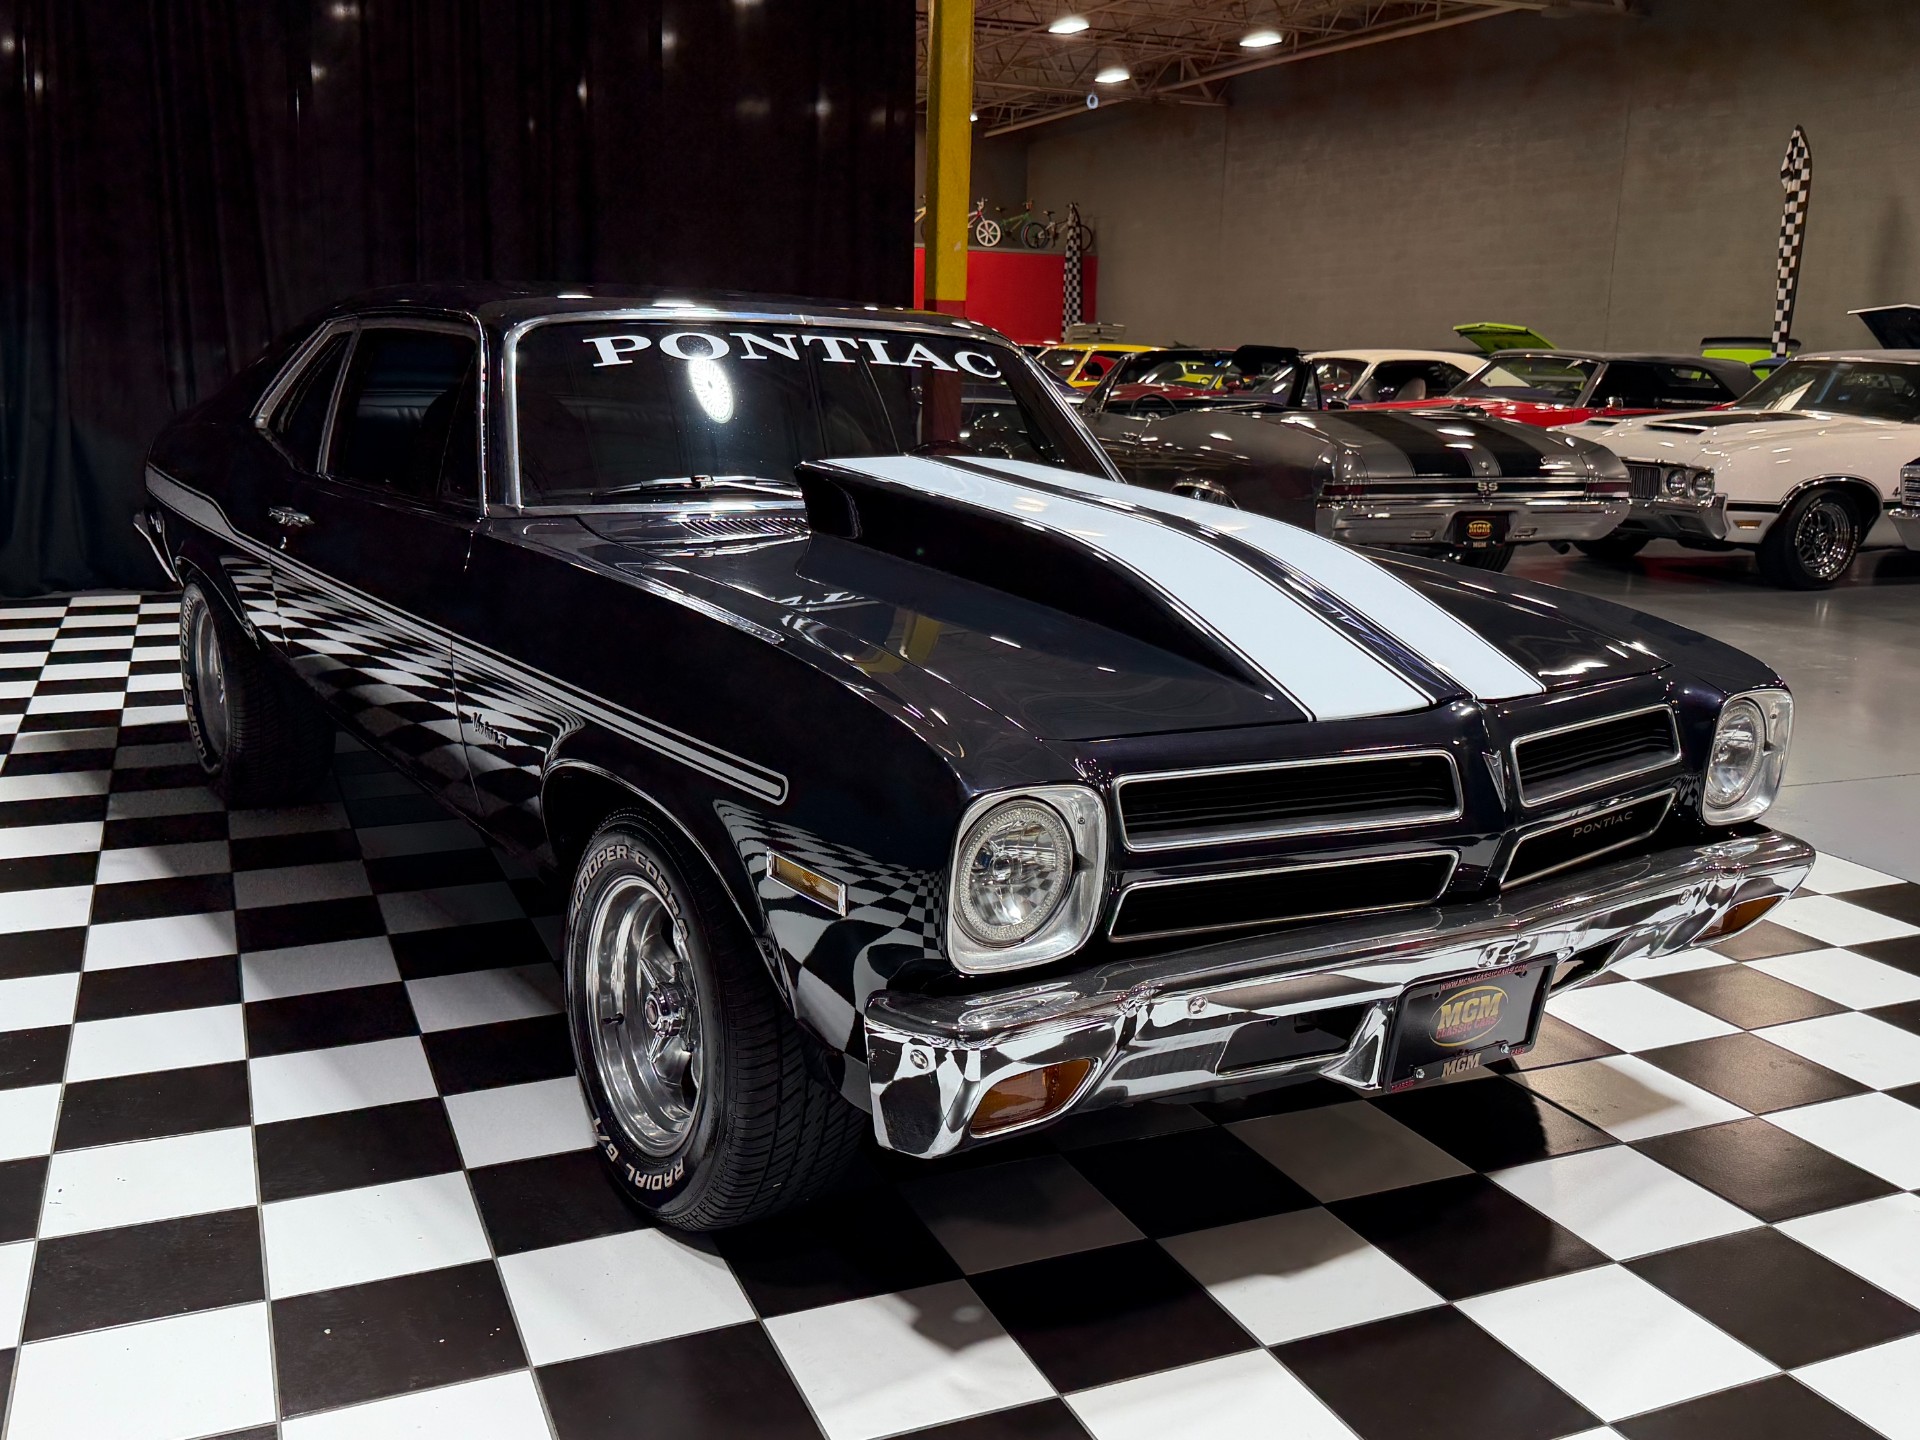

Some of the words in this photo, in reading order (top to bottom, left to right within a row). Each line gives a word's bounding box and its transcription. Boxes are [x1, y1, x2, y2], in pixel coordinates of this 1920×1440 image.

[582, 331, 1002, 380] PONTIAC
[1477, 481, 1499, 492] SS
[1468, 523, 1491, 533] MGM
[181, 597, 194, 662] COBRA
[184, 673, 208, 759] COOPER
[1572, 811, 1634, 838] PONTIAC
[573, 843, 630, 910] COOPER
[634, 849, 691, 941] COBRA
[1435, 1022, 1473, 1040] CLASSIC
[1473, 1016, 1498, 1029] CARS
[1437, 992, 1504, 1031] MGM
[1441, 1053, 1482, 1078] MGM
[625, 1157, 685, 1191] RADIAL
